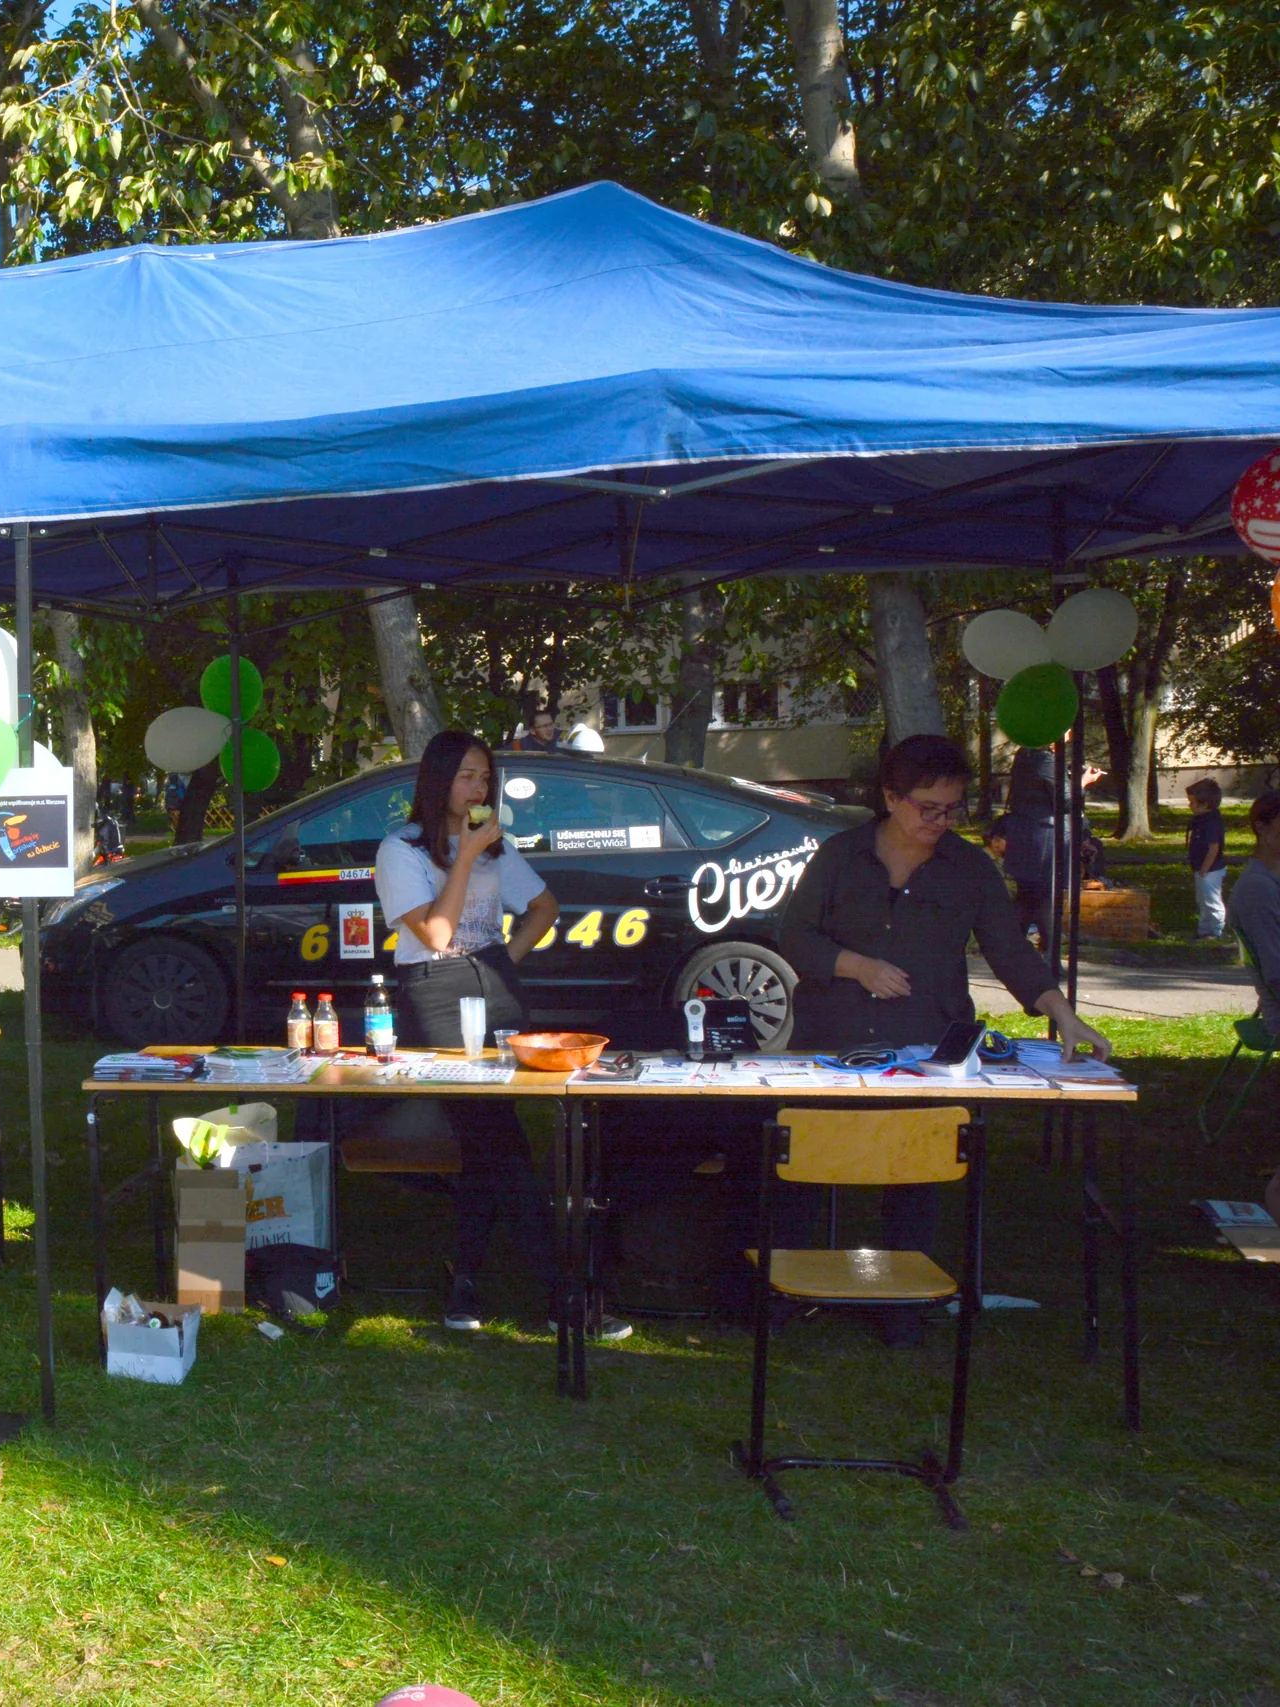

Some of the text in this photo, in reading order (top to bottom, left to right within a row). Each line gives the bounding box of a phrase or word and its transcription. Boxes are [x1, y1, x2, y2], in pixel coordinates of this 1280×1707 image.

[612, 829, 627, 838] SIĘ
[557, 840, 585, 850] Będzie
[586, 839, 601, 849] Cię
[340, 869, 371, 879] 04674
[688, 853, 815, 933] Cier
[316, 1272, 334, 1287] NIKE
